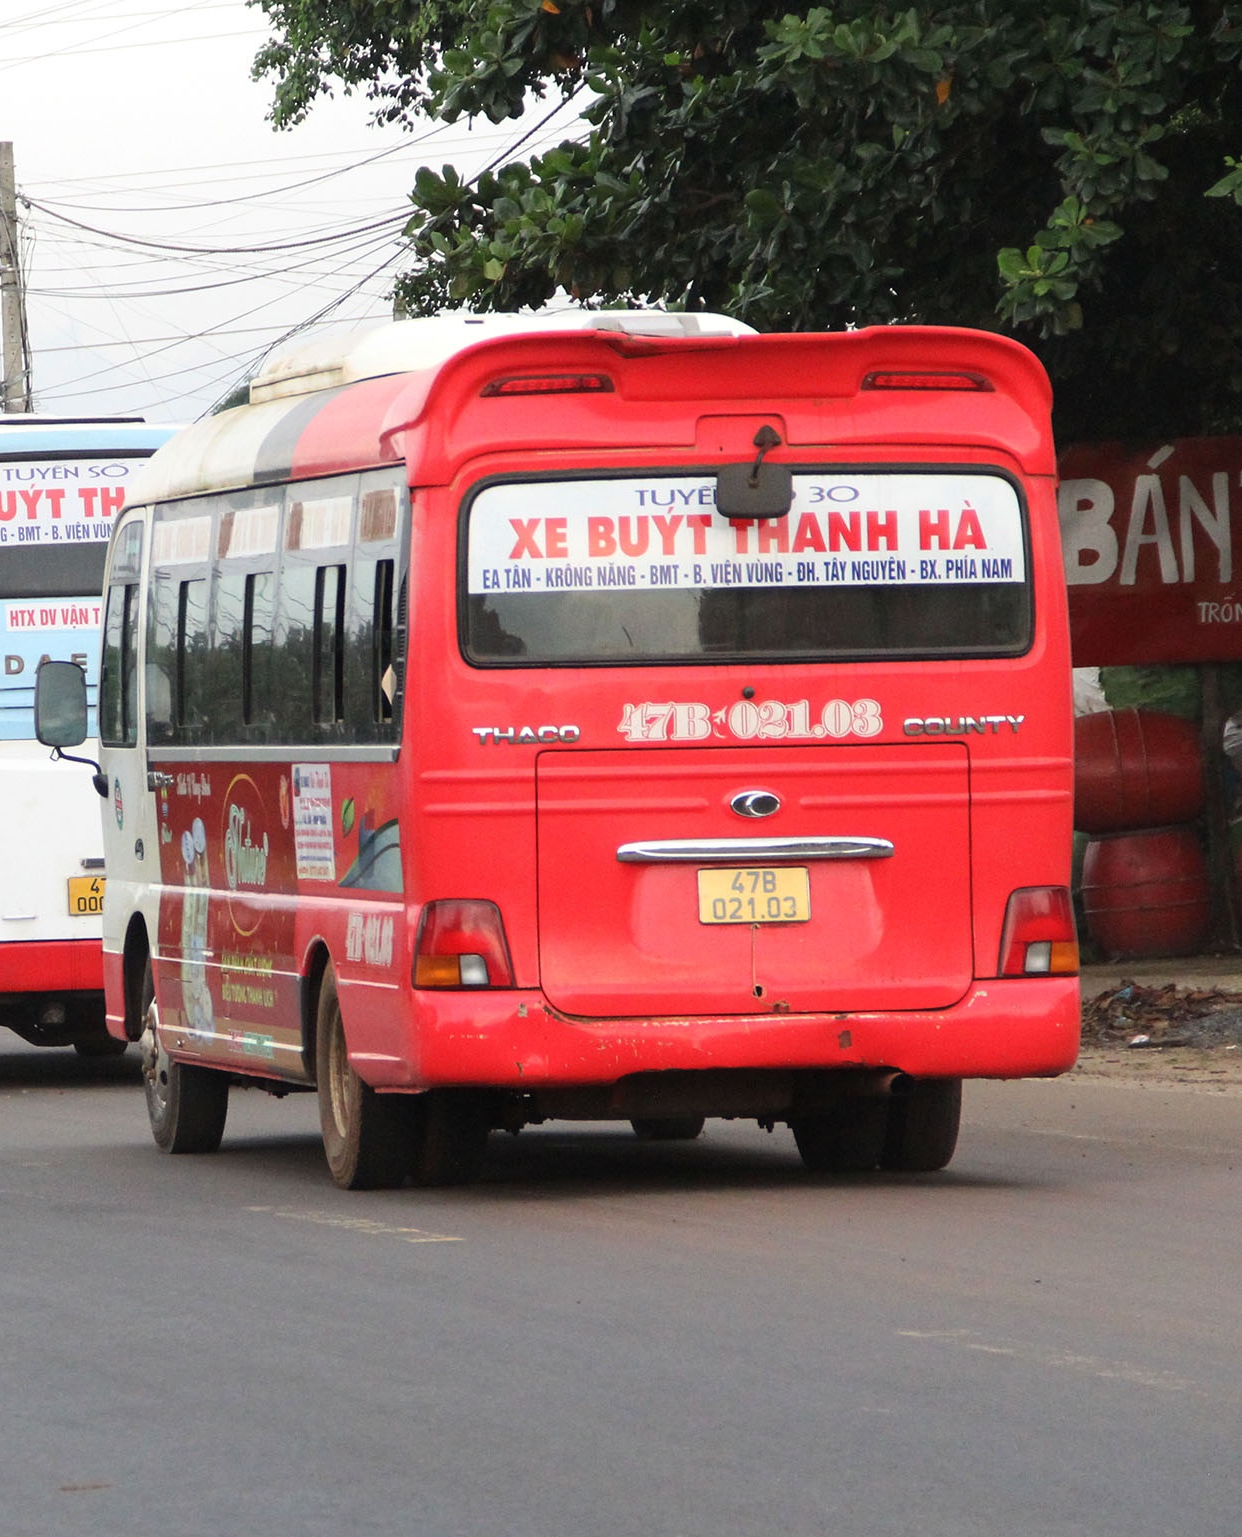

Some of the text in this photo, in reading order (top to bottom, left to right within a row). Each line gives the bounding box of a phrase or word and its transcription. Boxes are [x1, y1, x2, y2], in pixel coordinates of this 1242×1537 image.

[3, 462, 129, 481] TUYẾN SỐ
[78, 487, 125, 517] TH
[635, 485, 717, 506] TUYẾ
[809, 486, 860, 503] 30
[1058, 444, 1232, 586] BÁN
[18, 526, 41, 541] BMT
[52, 525, 63, 540] B.
[65, 521, 90, 539] VIỆN
[508, 500, 988, 559] XE BUÝT THANH HÀ
[482, 569, 501, 590] EA
[505, 565, 532, 589] TÂN
[545, 563, 592, 588] KRÔNG
[598, 562, 636, 586] NĂNG
[650, 565, 680, 586] BMT
[694, 564, 707, 585] B.
[711, 560, 742, 585] VIỆN
[747, 559, 783, 583] VÙNG
[824, 558, 847, 581] TÂY
[851, 557, 906, 580] NGUYÊN
[920, 559, 941, 580] BX.
[946, 555, 977, 579] PHÍA
[981, 558, 1012, 579] NAM
[10, 609, 36, 627] HTX
[40, 608, 57, 626] DV
[61, 604, 89, 629] VẬN
[472, 725, 581, 745] THACO
[903, 715, 1025, 736] COUNTY
[731, 871, 777, 894] 47B
[712, 896, 797, 920] 021.03
